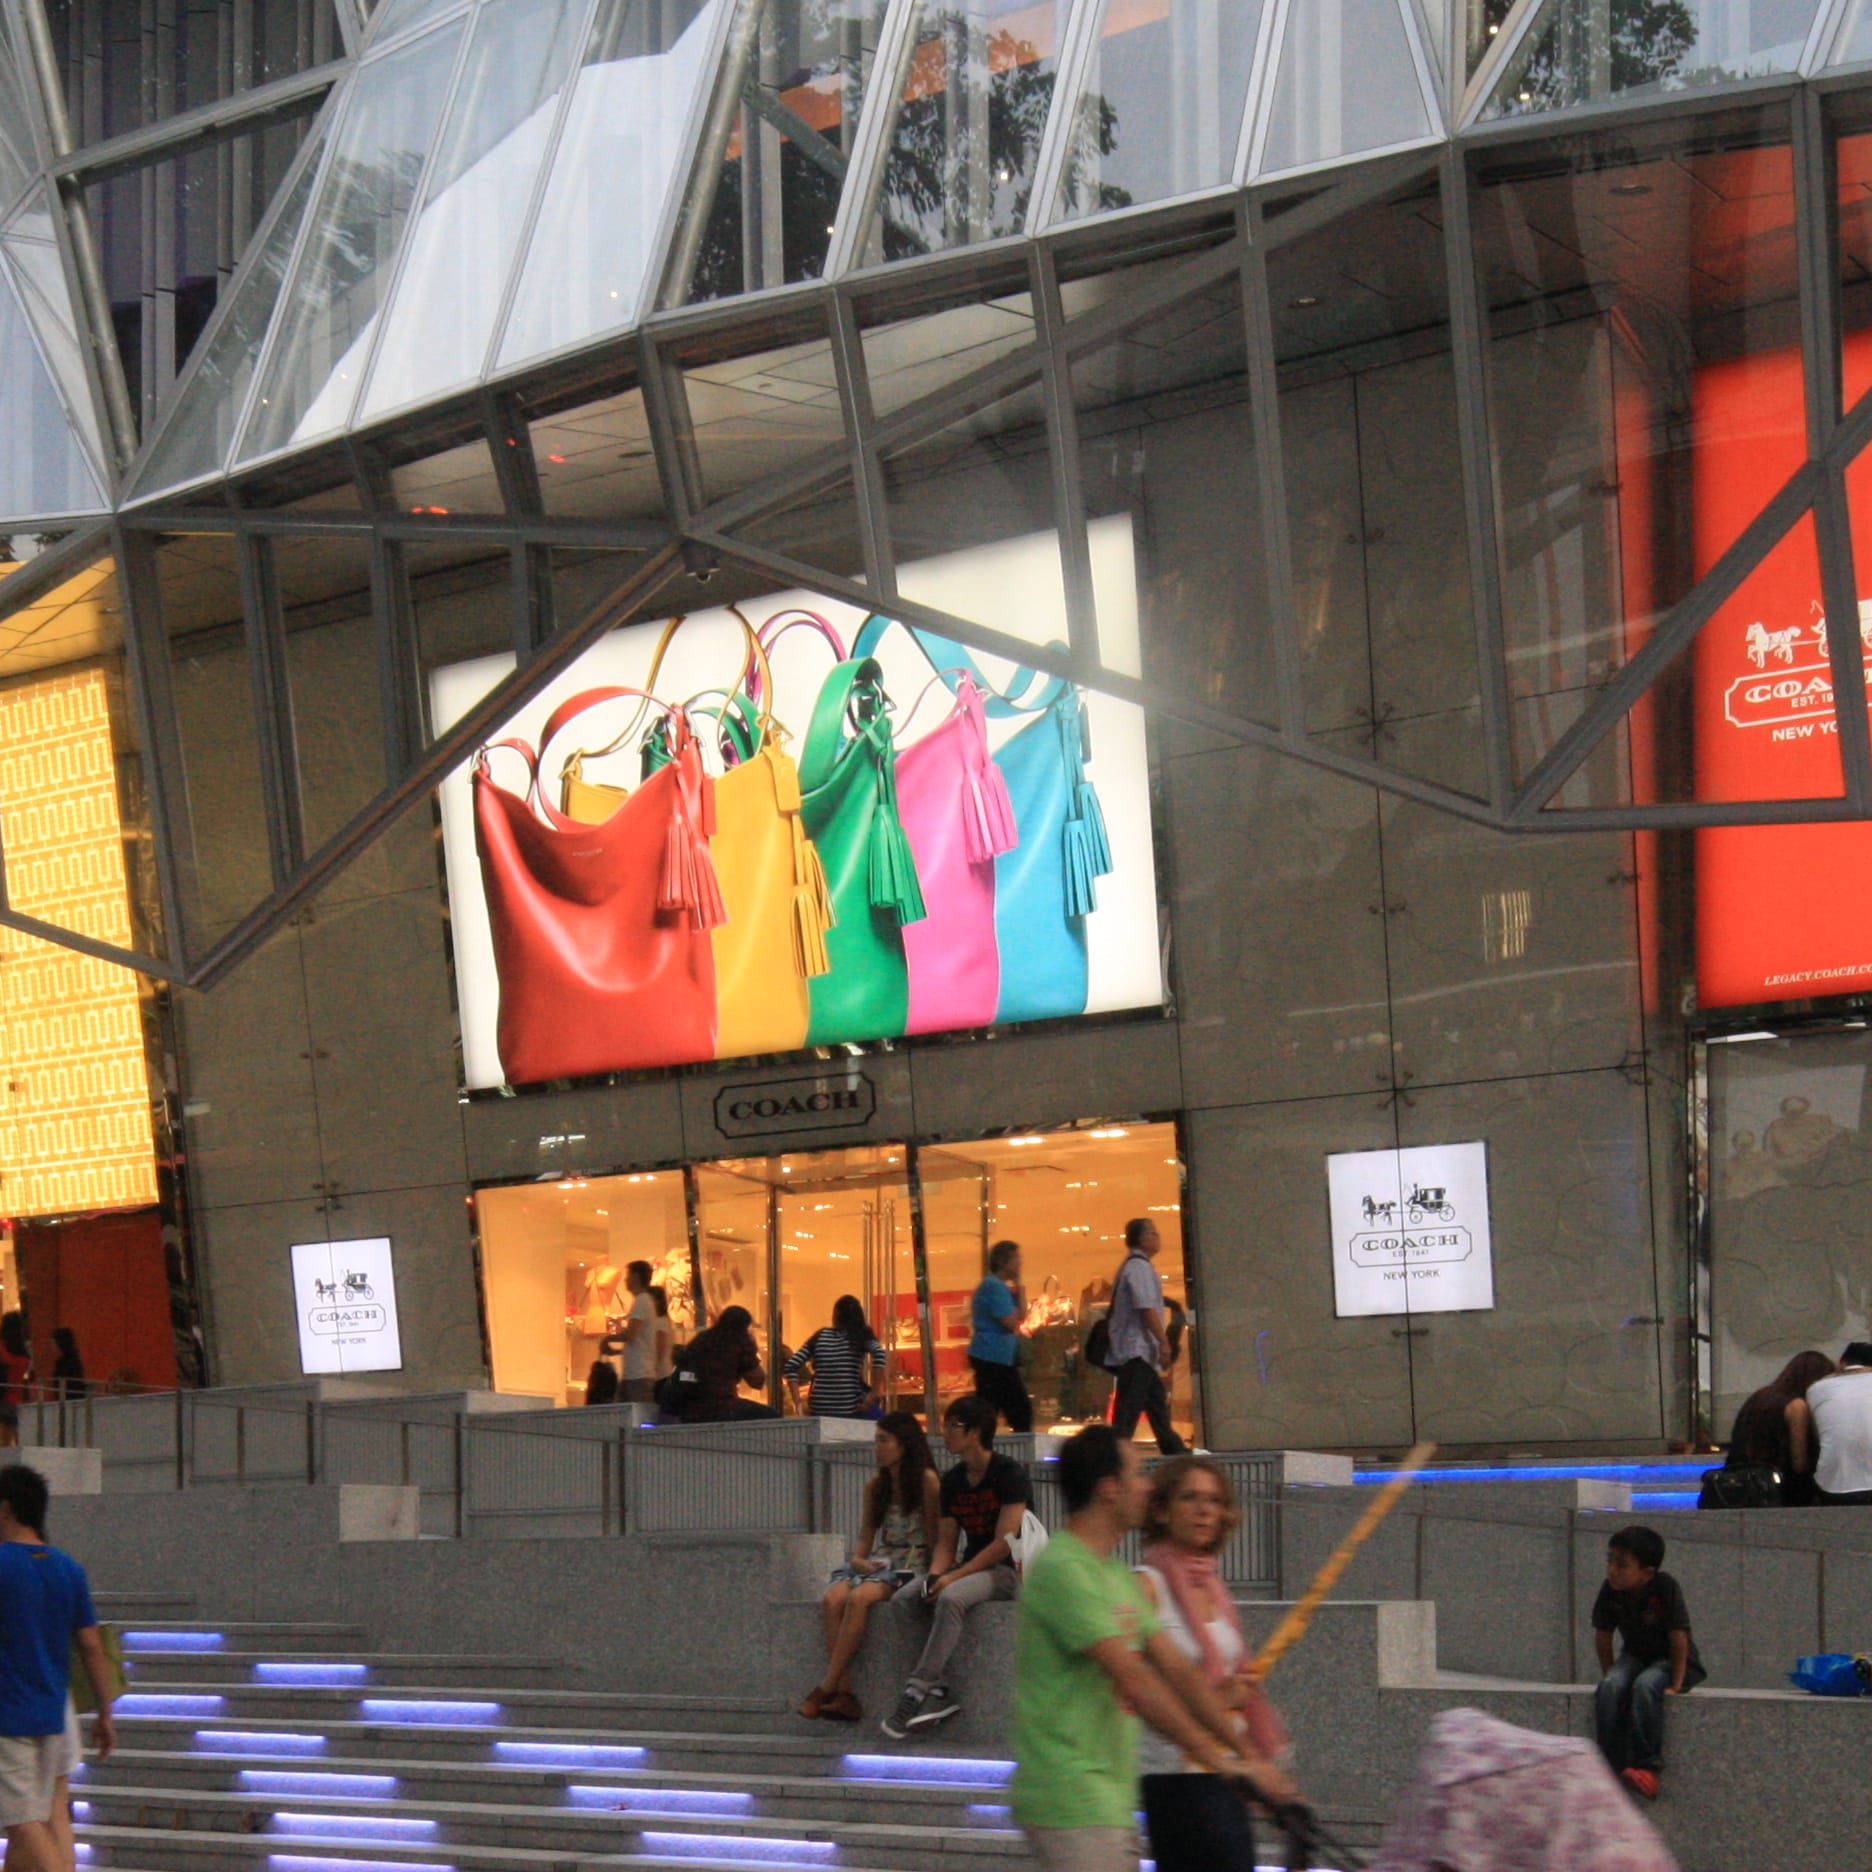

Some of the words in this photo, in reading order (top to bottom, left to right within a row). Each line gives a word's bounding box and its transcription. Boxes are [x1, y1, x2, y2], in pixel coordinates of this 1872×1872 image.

[1772, 724, 1814, 742] NEW
[729, 1091, 860, 1121] COACH
[1362, 1234, 1459, 1251] COACH
[1383, 1271, 1407, 1280] NEW
[1412, 1269, 1440, 1279] YORK
[316, 1310, 378, 1323] COACH
